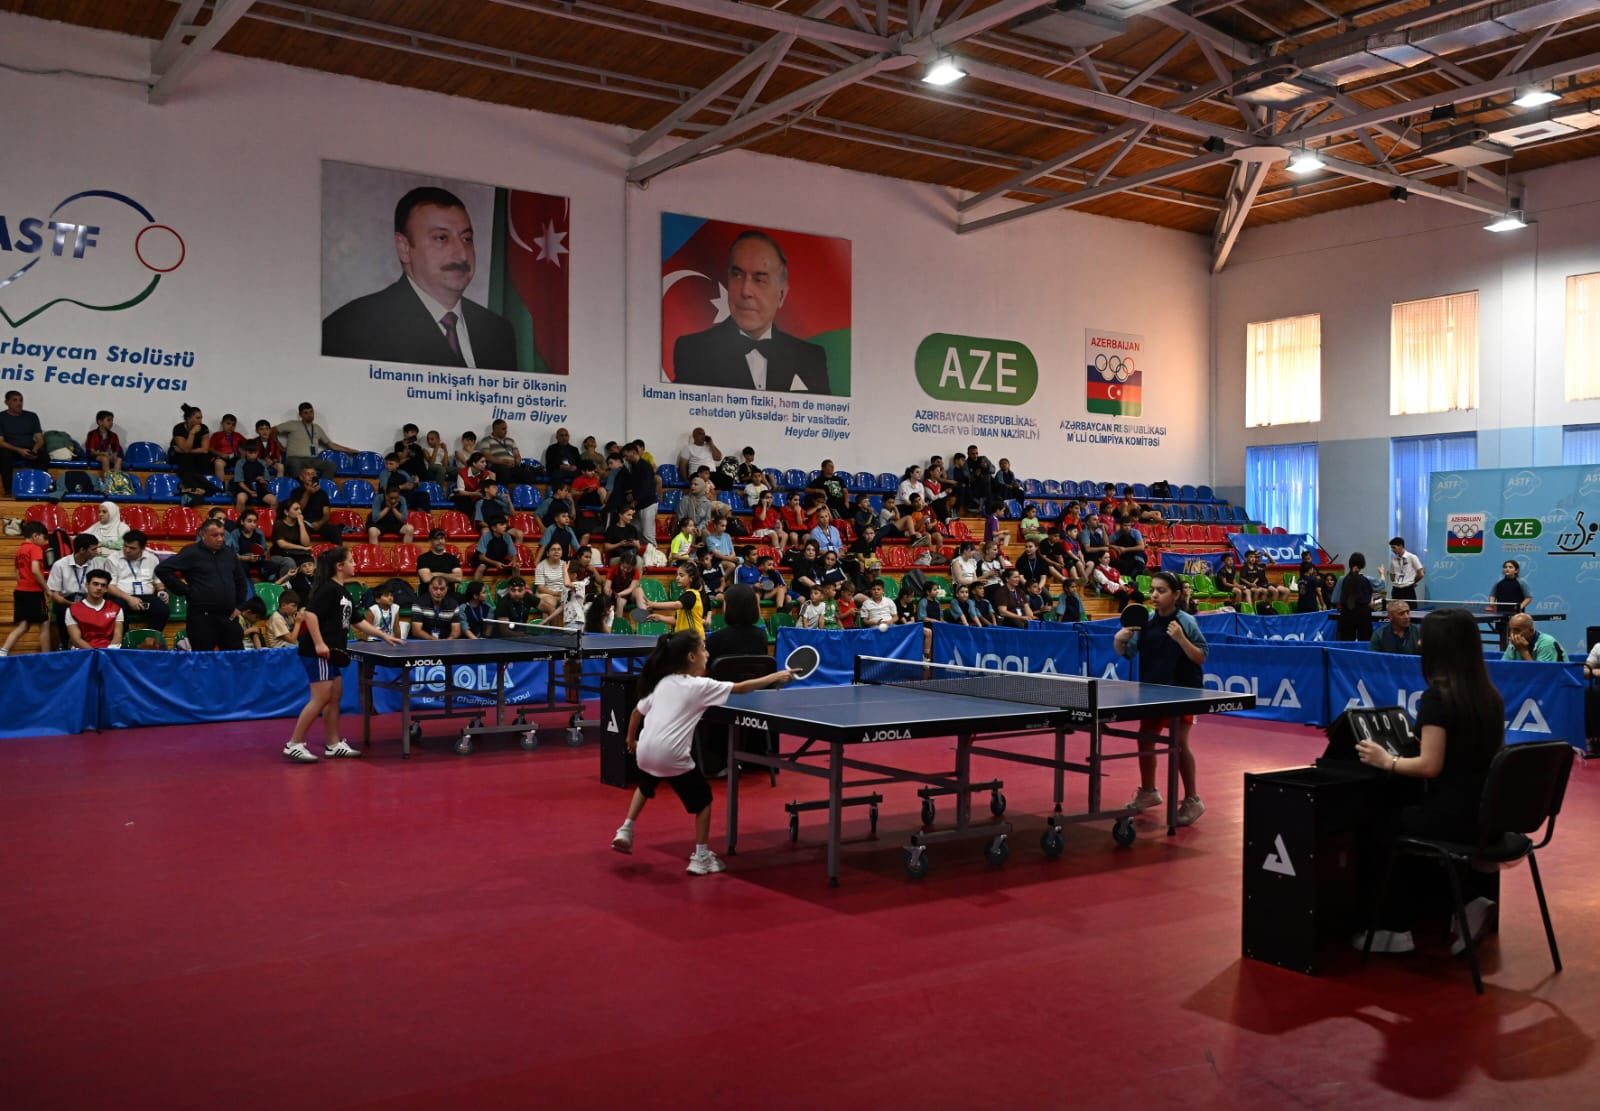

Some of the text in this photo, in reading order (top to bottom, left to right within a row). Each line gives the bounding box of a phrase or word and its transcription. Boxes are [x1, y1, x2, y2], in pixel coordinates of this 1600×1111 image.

[0, 336, 195, 368] rbaycan Stolüstü
[1091, 337, 1141, 352] AZERBAIJAN
[0, 363, 188, 393] nis Federasiyası
[369, 363, 567, 392] İdmanın inkişafı hər bir ölkənin
[938, 346, 1017, 394] AZE
[407, 386, 567, 408] ümumi inkişafını göstərir.
[643, 384, 850, 413] İdman insanları həm fiziki, həm də mənəvi
[492, 405, 568, 424] İlham Əliyev
[689, 406, 736, 419] cəhətdən
[791, 412, 805, 424] bir
[807, 414, 850, 426] vasitədir.
[915, 409, 1038, 428] AZƏRBAYCAN RESPUBLİKAS
[785, 426, 851, 441] Heydər Əliyev
[912, 422, 955, 435] GƏNCLƏR
[957, 425, 969, 436] VƏ
[972, 424, 999, 438] İDMAN
[1059, 420, 1112, 432] AZƏRBAYCAN
[1067, 431, 1087, 443] MLLİ
[1507, 477, 1531, 487] ASTF
[1502, 522, 1534, 536] AZE
[1557, 533, 1596, 545] ITTF
[1203, 673, 1301, 709] OOLA
[1215, 701, 1243, 713] JOOLA
[740, 716, 768, 730] JOOLA
[1398, 712, 1415, 738] 2
[871, 729, 912, 741] JOOLA
